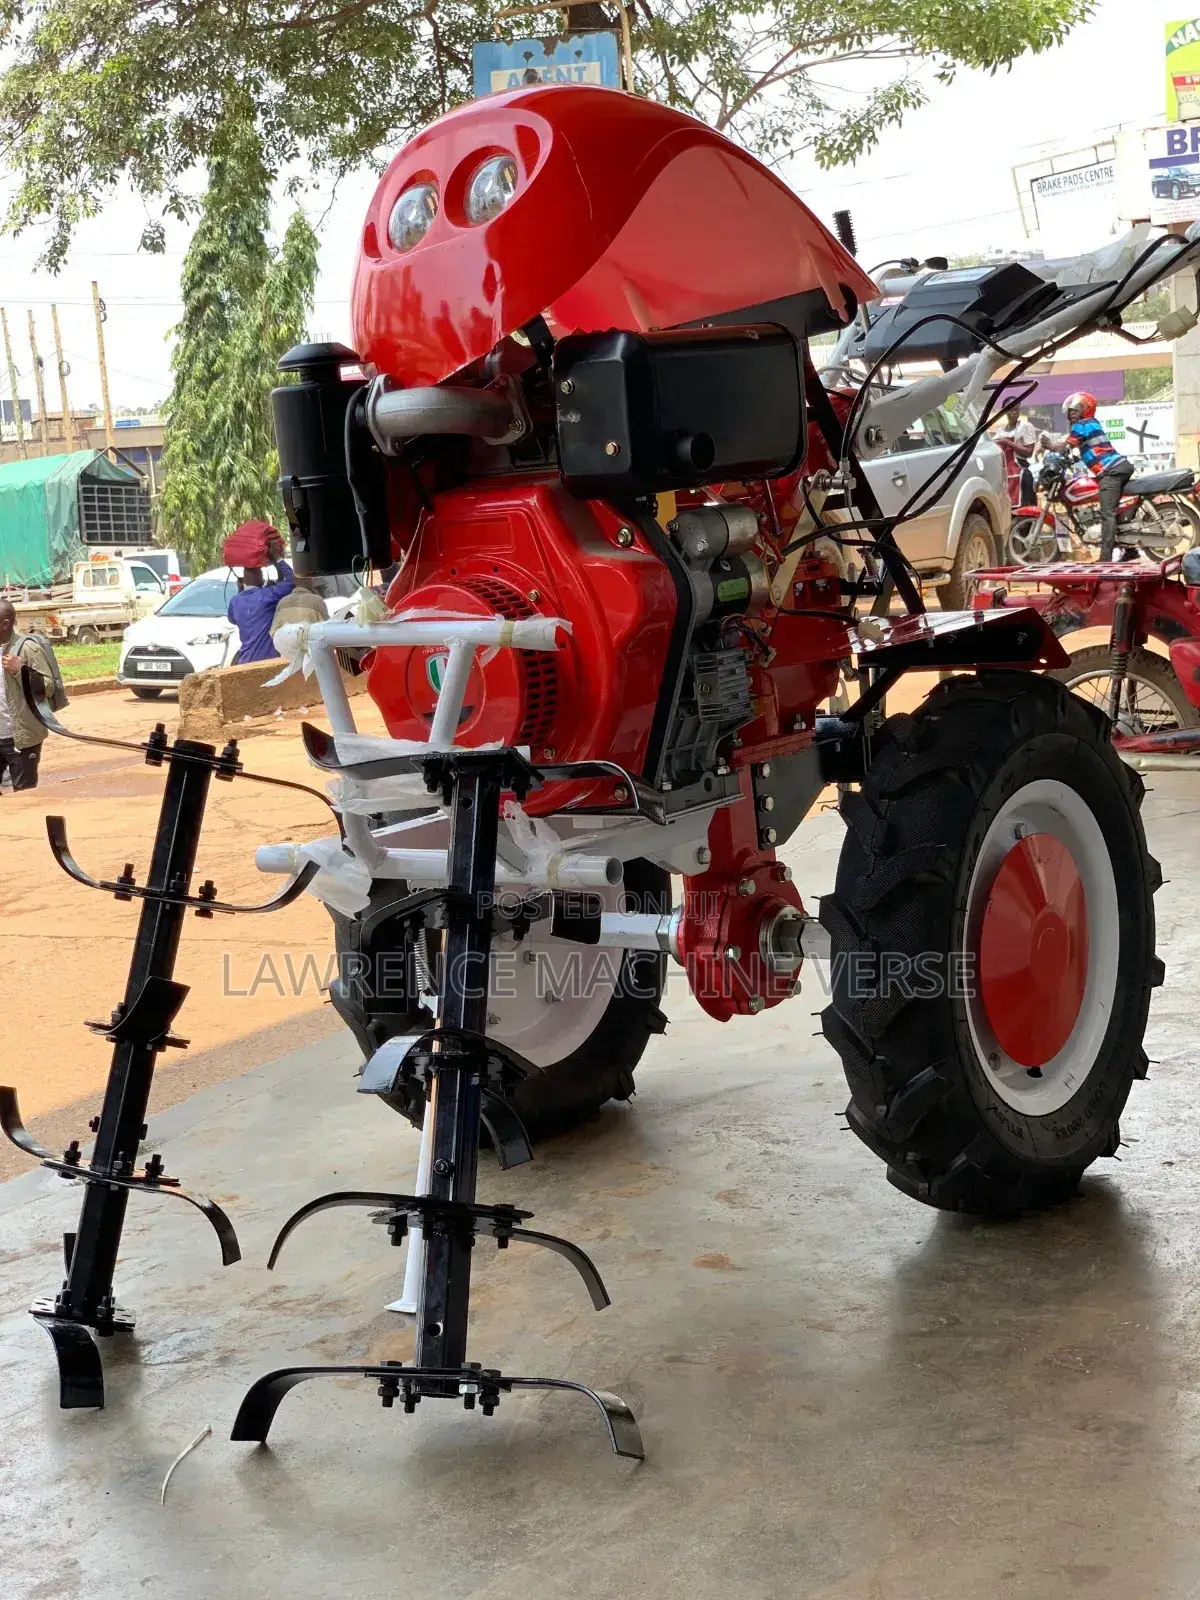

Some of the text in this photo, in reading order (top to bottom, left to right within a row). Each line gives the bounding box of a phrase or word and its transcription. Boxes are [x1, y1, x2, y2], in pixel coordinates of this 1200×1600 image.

[1169, 18, 1200, 49] NA
[1036, 177, 1062, 194] BRAKE
[1063, 172, 1084, 187] PADS
[1084, 165, 1115, 184] CENTRE
